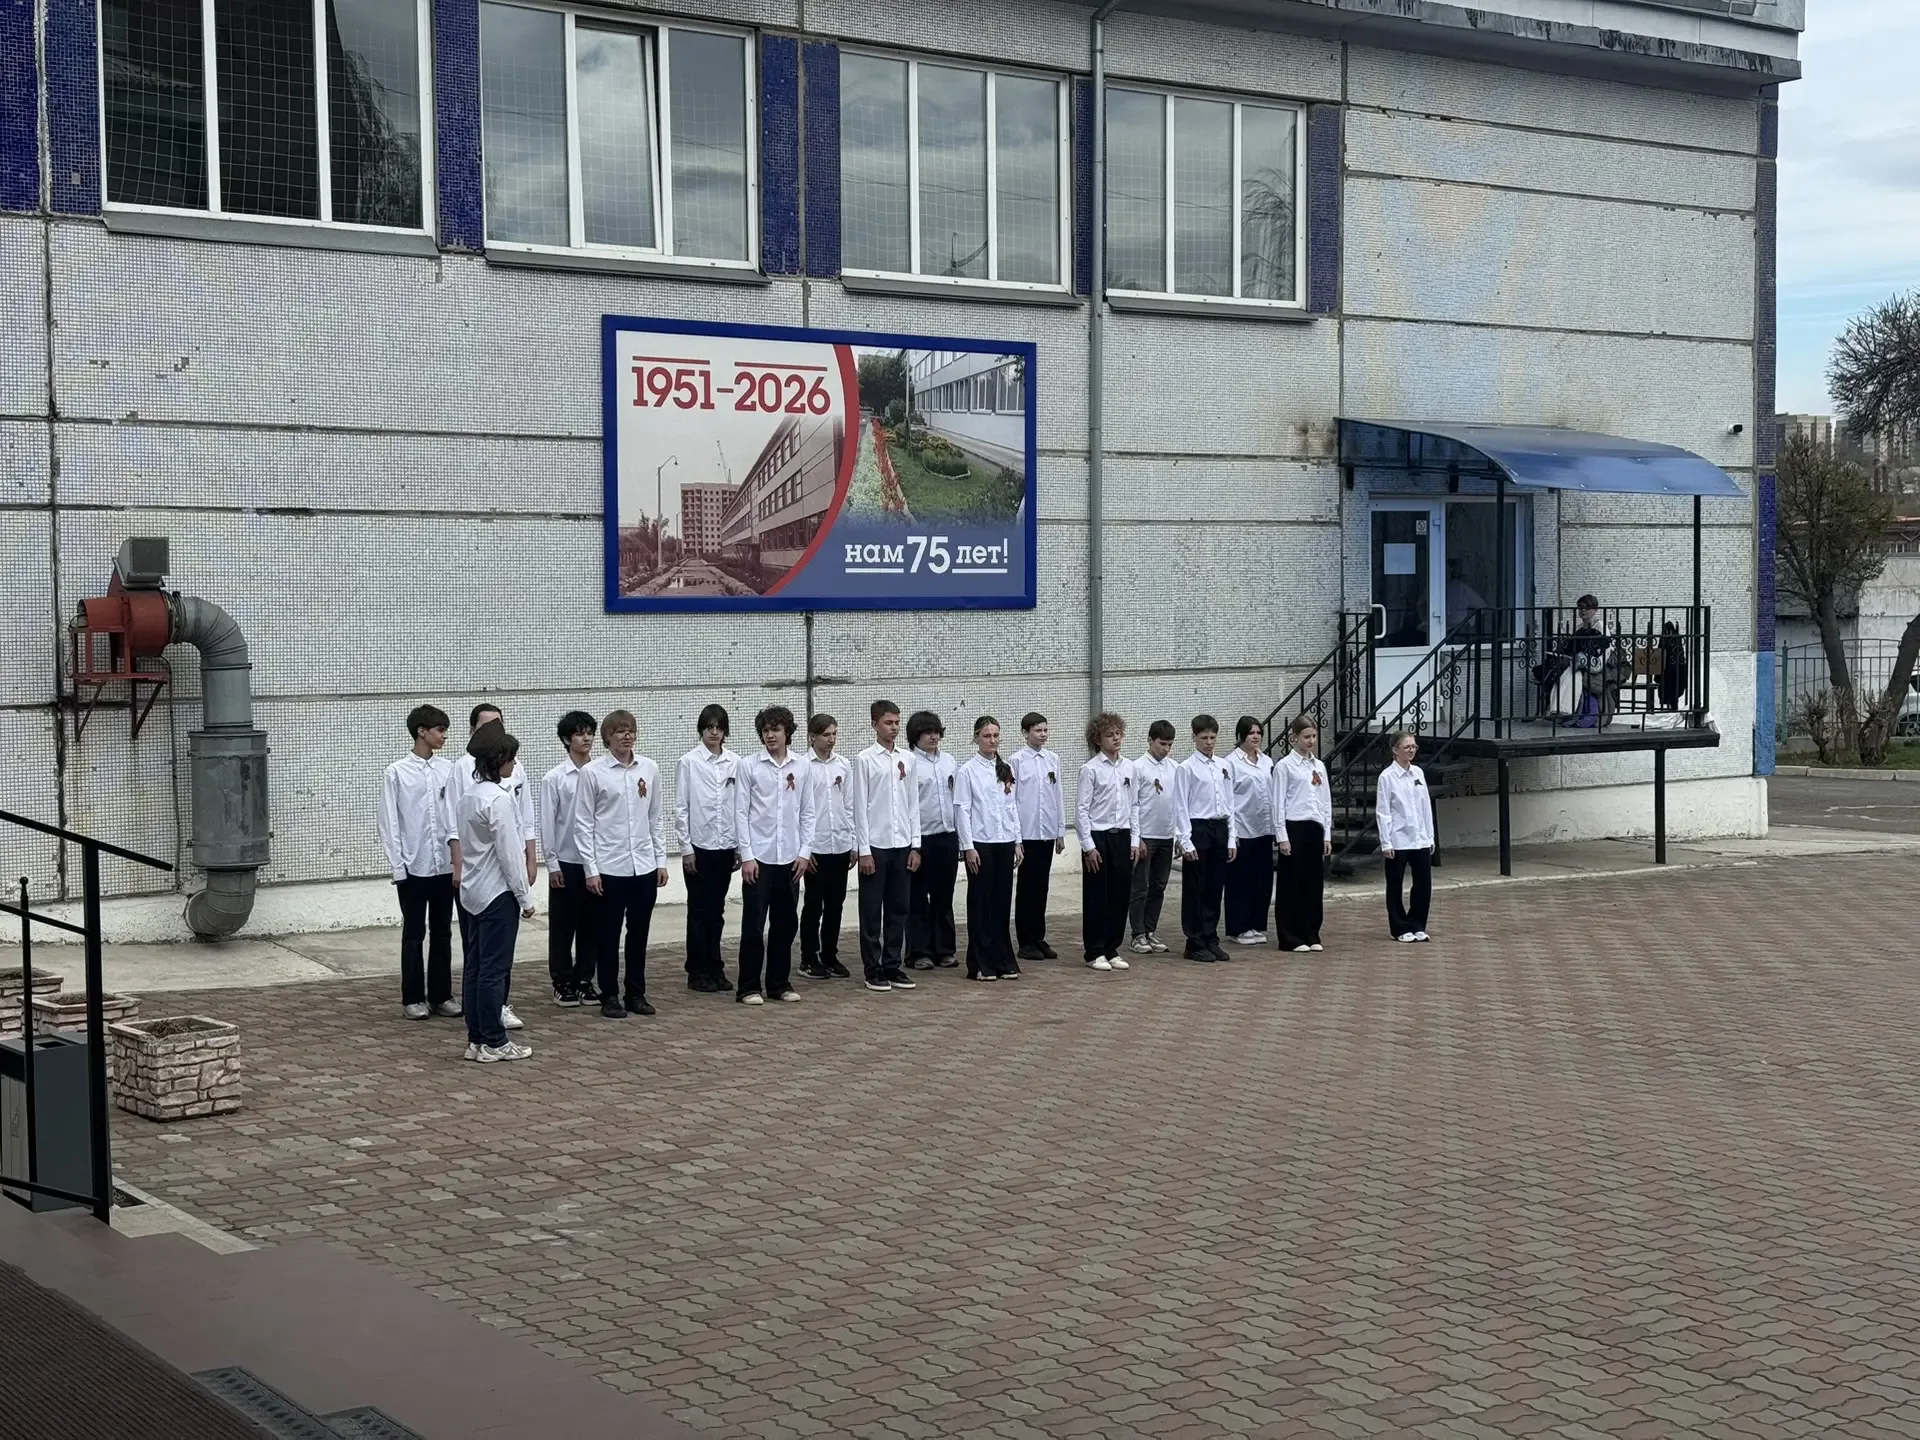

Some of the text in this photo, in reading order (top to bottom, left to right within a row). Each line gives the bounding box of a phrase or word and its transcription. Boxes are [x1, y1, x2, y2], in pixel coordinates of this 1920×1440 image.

[632, 366, 831, 415] 1951-2026
[845, 536, 1008, 574] нам 75 лет!
